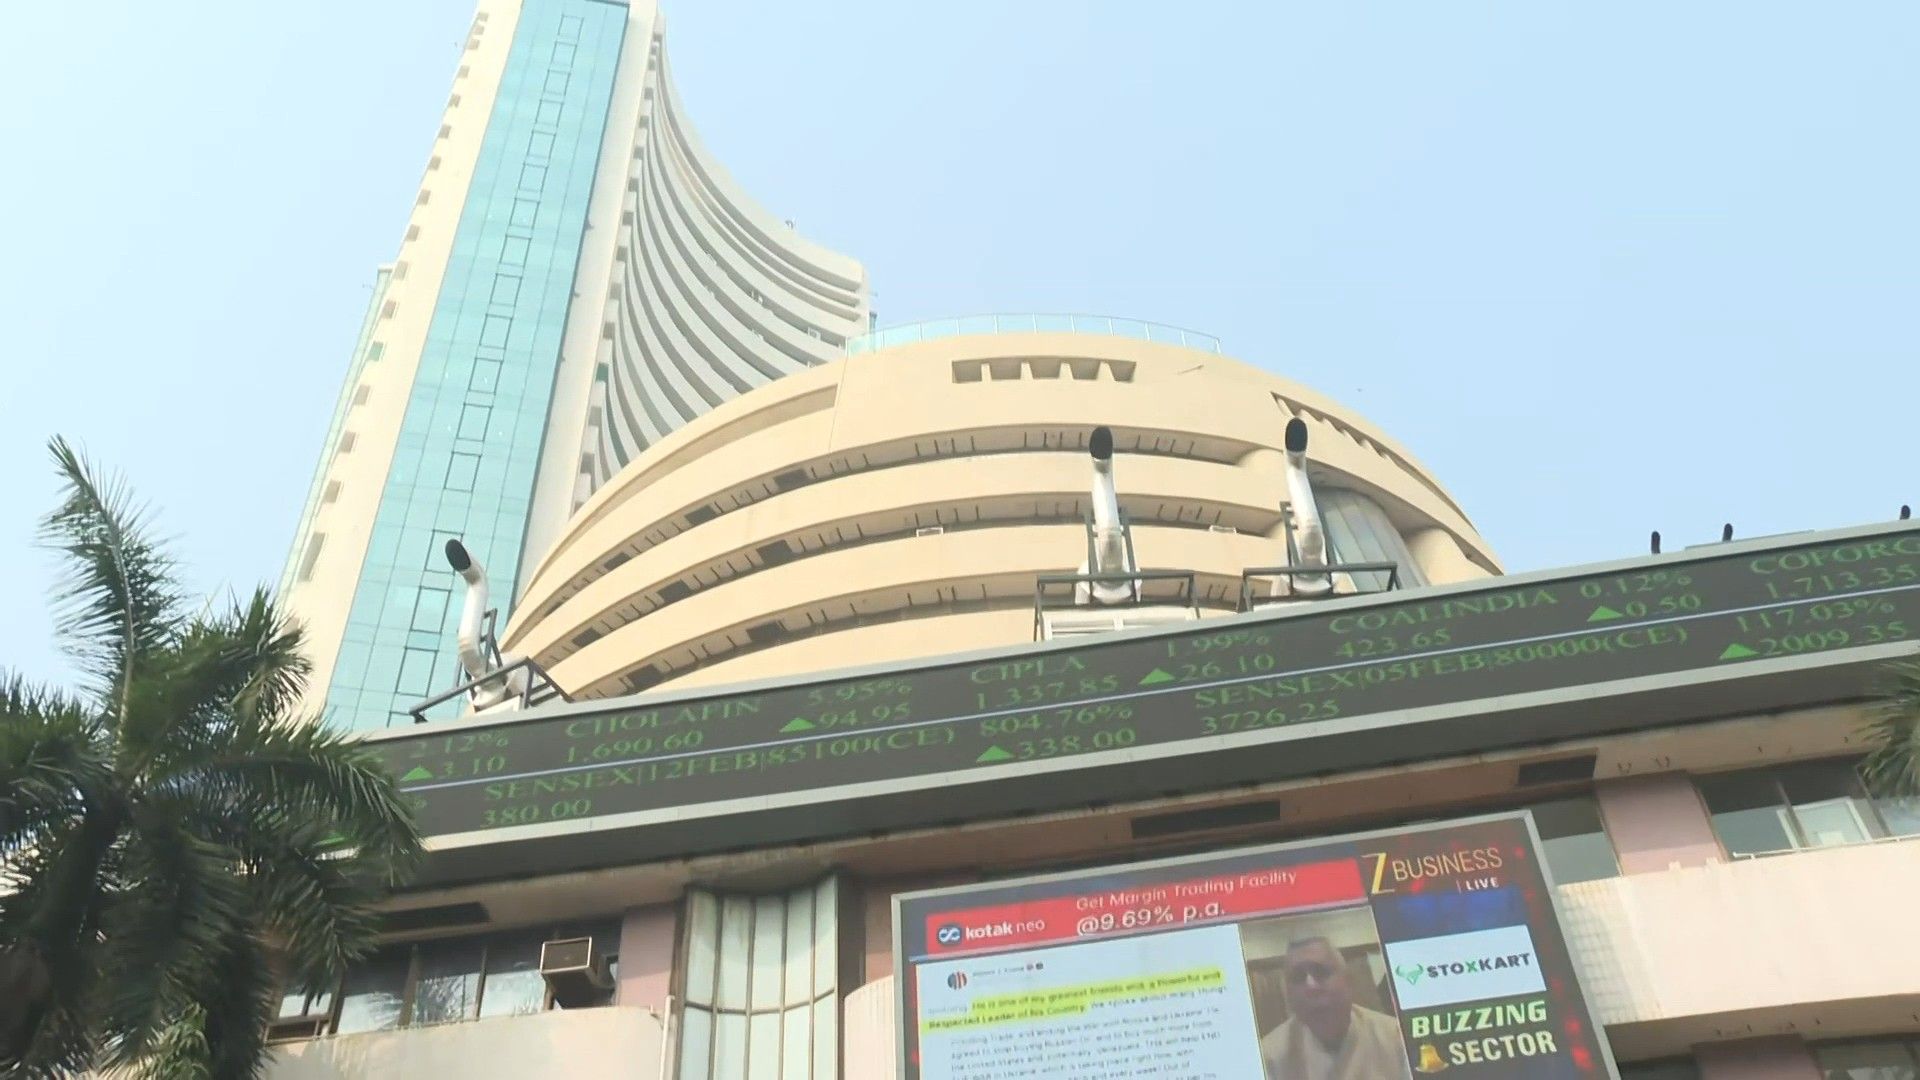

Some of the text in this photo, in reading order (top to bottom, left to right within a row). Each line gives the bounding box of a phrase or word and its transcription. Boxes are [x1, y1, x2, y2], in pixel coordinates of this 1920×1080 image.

[1391, 847, 1503, 882] BUSINESS
[1076, 868, 1298, 911] Get Margin Trading Facility
[1465, 876, 1500, 891] LIVE
[965, 918, 1046, 942] kotak neo
[1076, 901, 1226, 937] @9.69% p.a.
[1426, 952, 1531, 979] STOXKART
[1411, 1000, 1547, 1039] BUZZING
[1448, 1030, 1558, 1067] SECTOR
